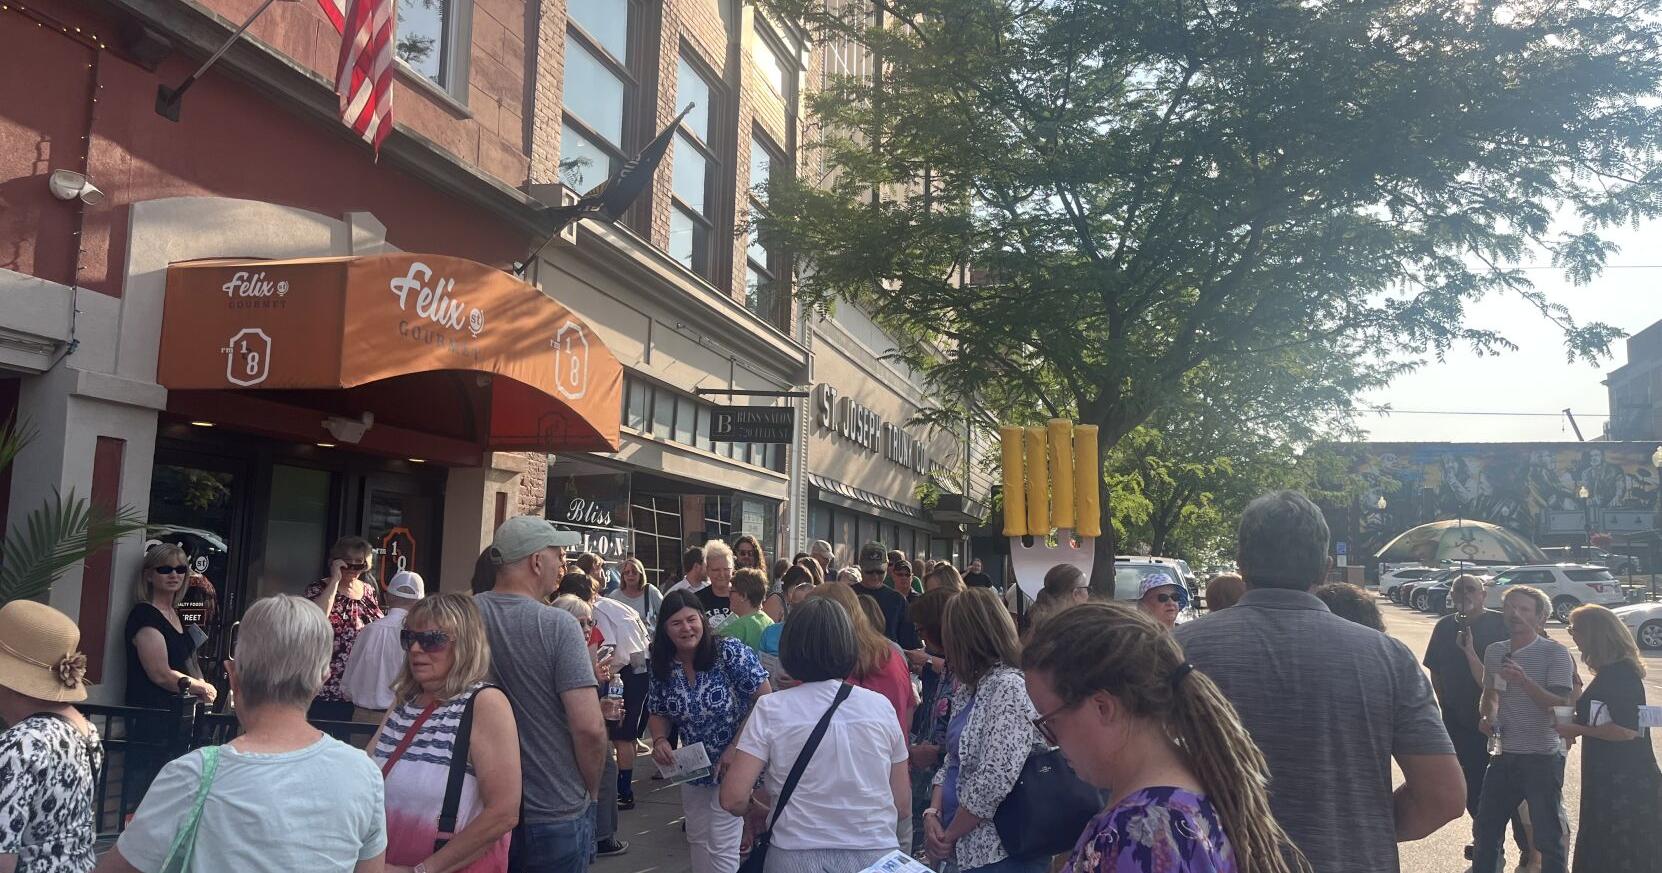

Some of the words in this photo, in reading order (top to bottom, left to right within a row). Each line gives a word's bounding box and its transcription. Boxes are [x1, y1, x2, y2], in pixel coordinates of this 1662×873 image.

[222, 271, 274, 297] Felix
[389, 262, 466, 330] Felix
[228, 300, 287, 309] GOURMET
[718, 414, 732, 433] B
[840, 397, 881, 453] JOSEPH
[566, 497, 611, 525] Bliss
